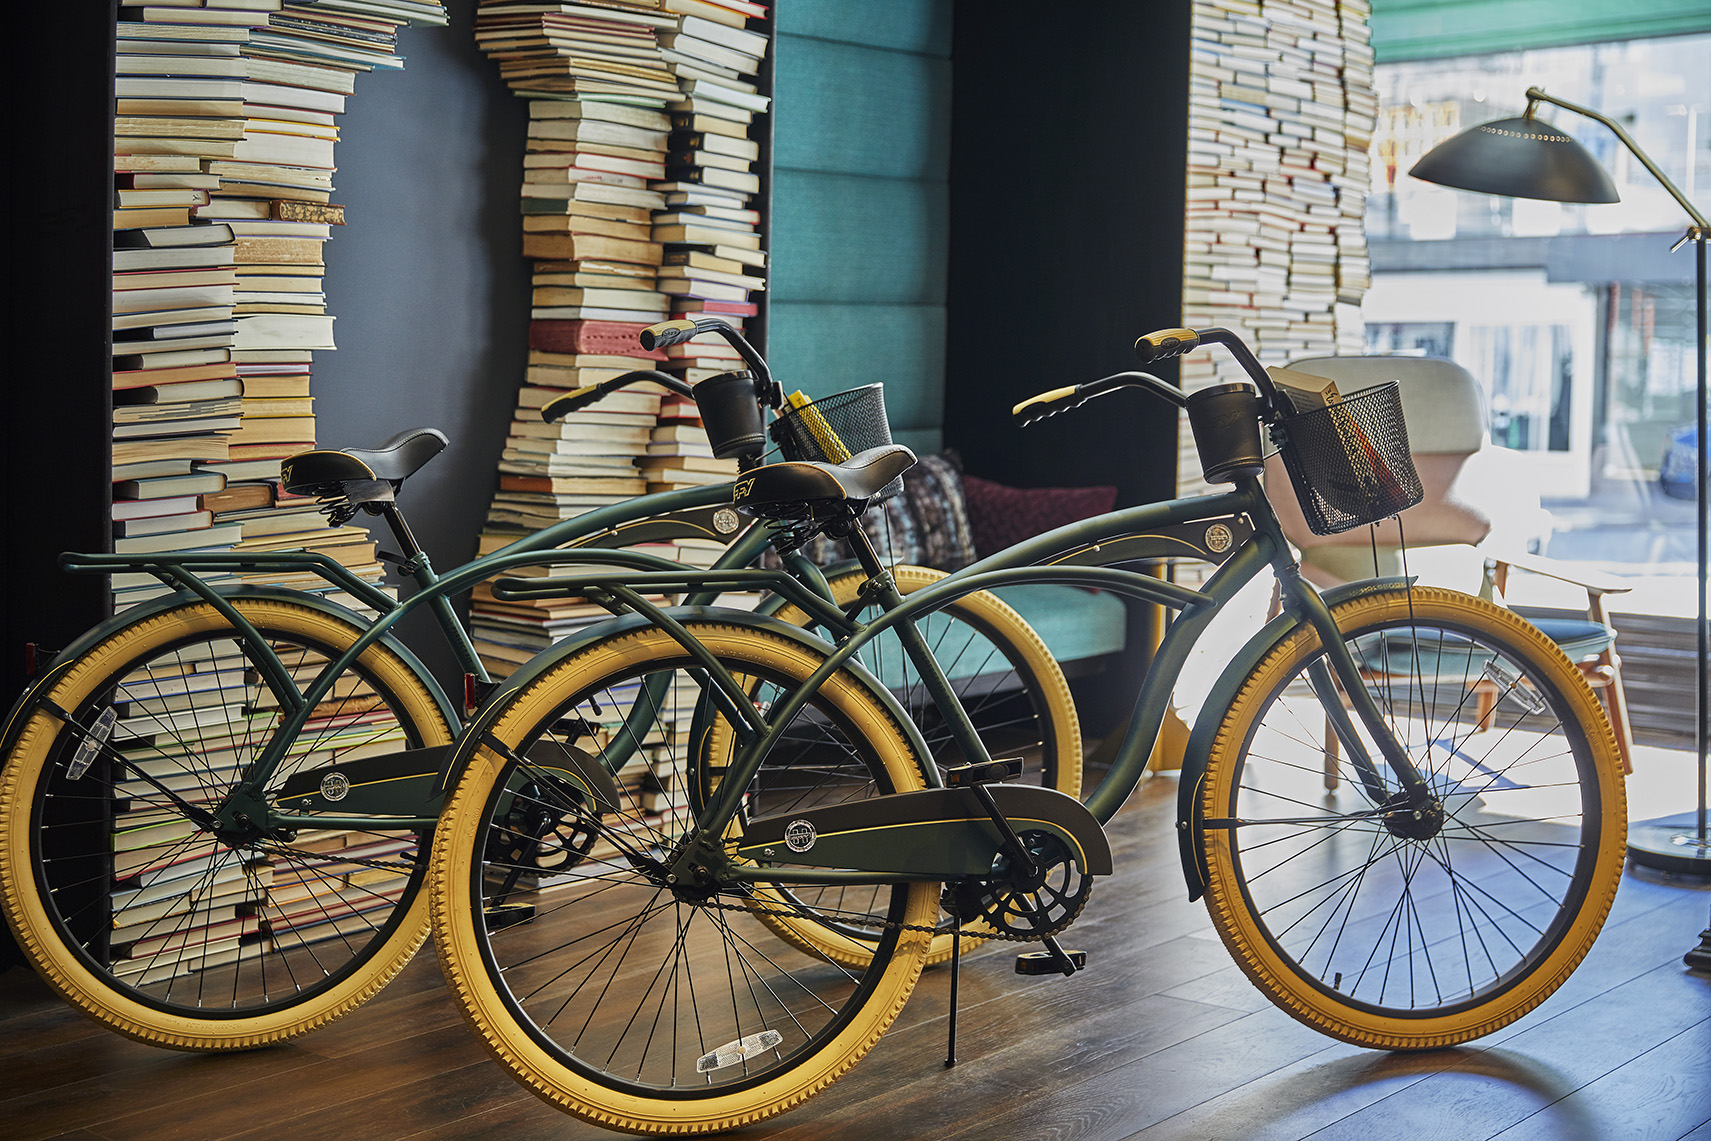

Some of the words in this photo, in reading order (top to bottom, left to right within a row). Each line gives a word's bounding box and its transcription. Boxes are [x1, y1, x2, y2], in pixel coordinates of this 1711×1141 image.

[451, 626, 468, 652] PERFECT
[919, 651, 939, 681] PERFECT
[945, 695, 970, 735] FRAME
